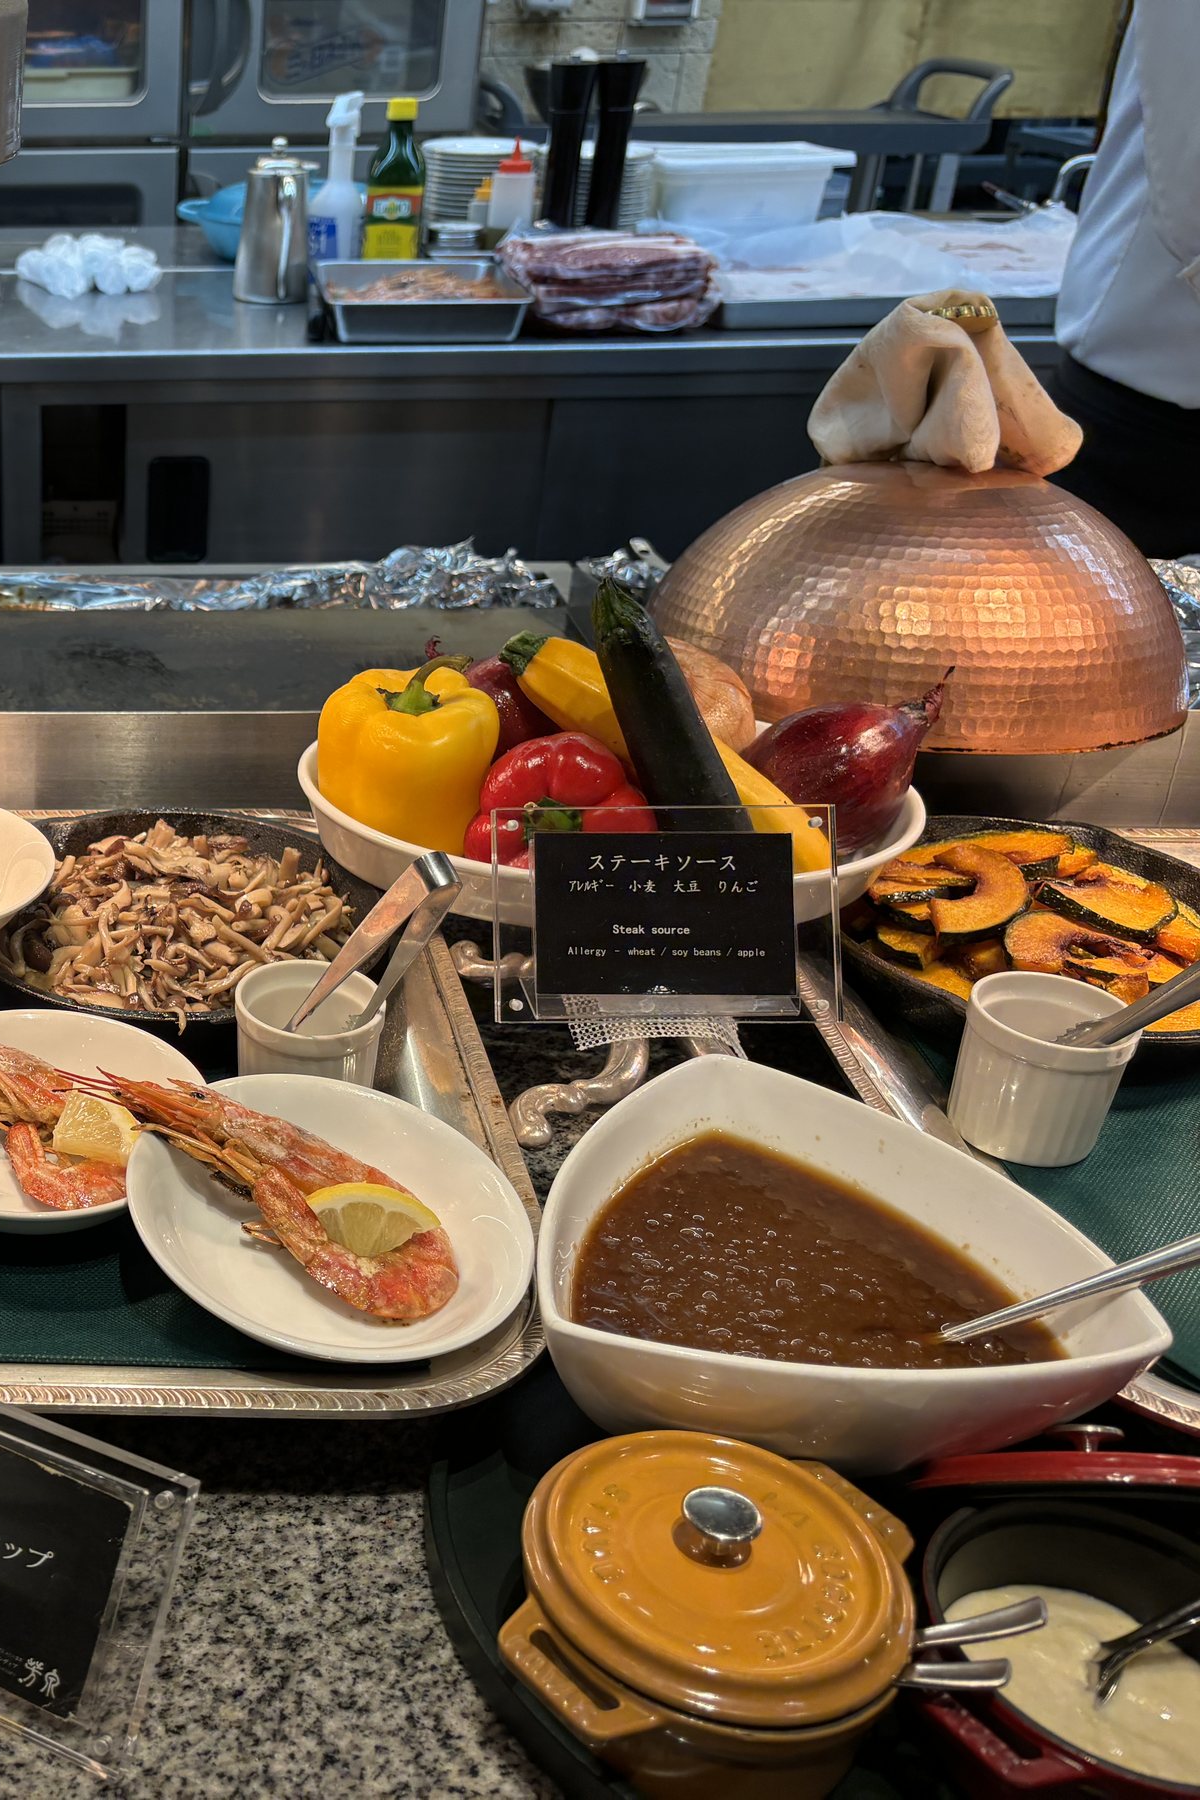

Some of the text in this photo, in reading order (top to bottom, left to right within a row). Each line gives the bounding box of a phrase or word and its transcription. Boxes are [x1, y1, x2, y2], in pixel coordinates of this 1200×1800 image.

[588, 853, 736, 872] ステーキソース
[629, 879, 657, 893] 小麦
[673, 879, 701, 893] 大豆
[718, 880, 759, 894] りんご
[612, 924, 691, 935] Steak source
[567, 946, 607, 957] Allergy
[627, 946, 656, 956] wheat
[671, 949, 689, 958] soy
[693, 947, 722, 957] beans
[737, 947, 766, 958] apple
